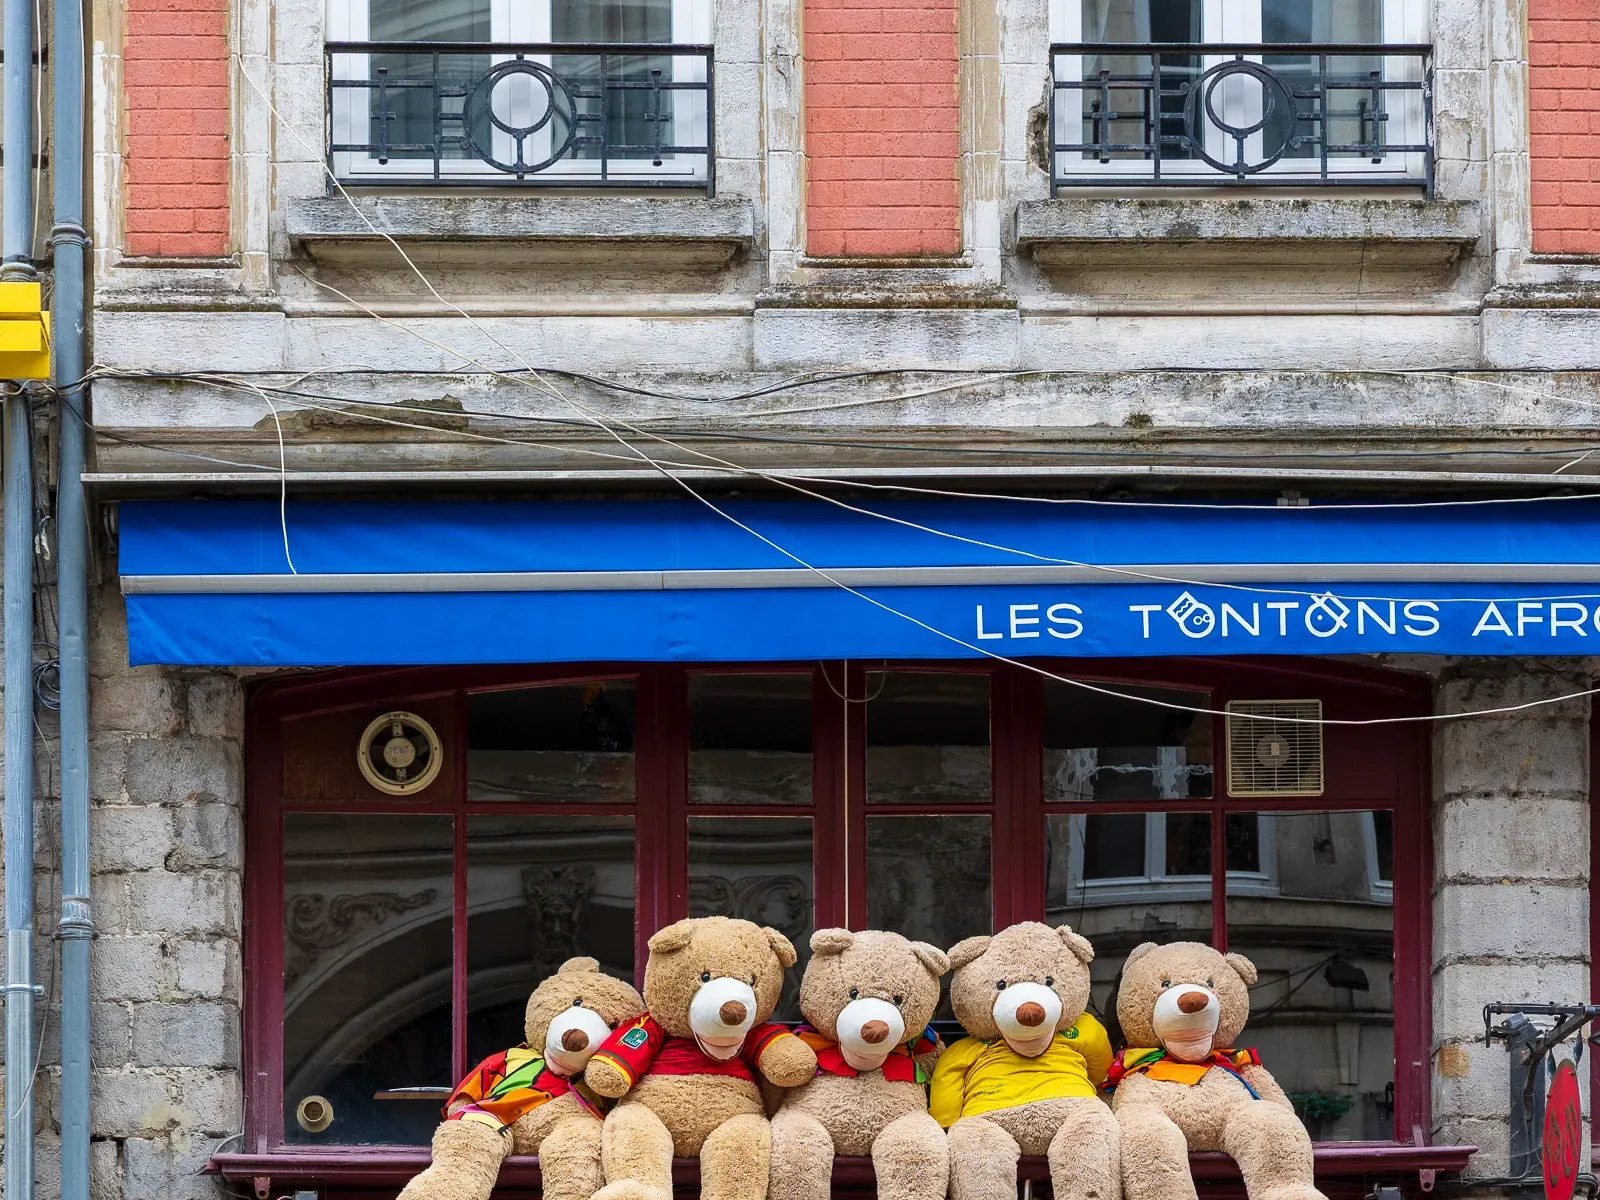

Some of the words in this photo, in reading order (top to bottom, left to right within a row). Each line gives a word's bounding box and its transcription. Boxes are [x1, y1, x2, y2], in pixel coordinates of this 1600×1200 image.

[976, 603, 1084, 640] LES
[1129, 591, 1440, 639] TONTONS
[1471, 601, 1600, 637] AFR
